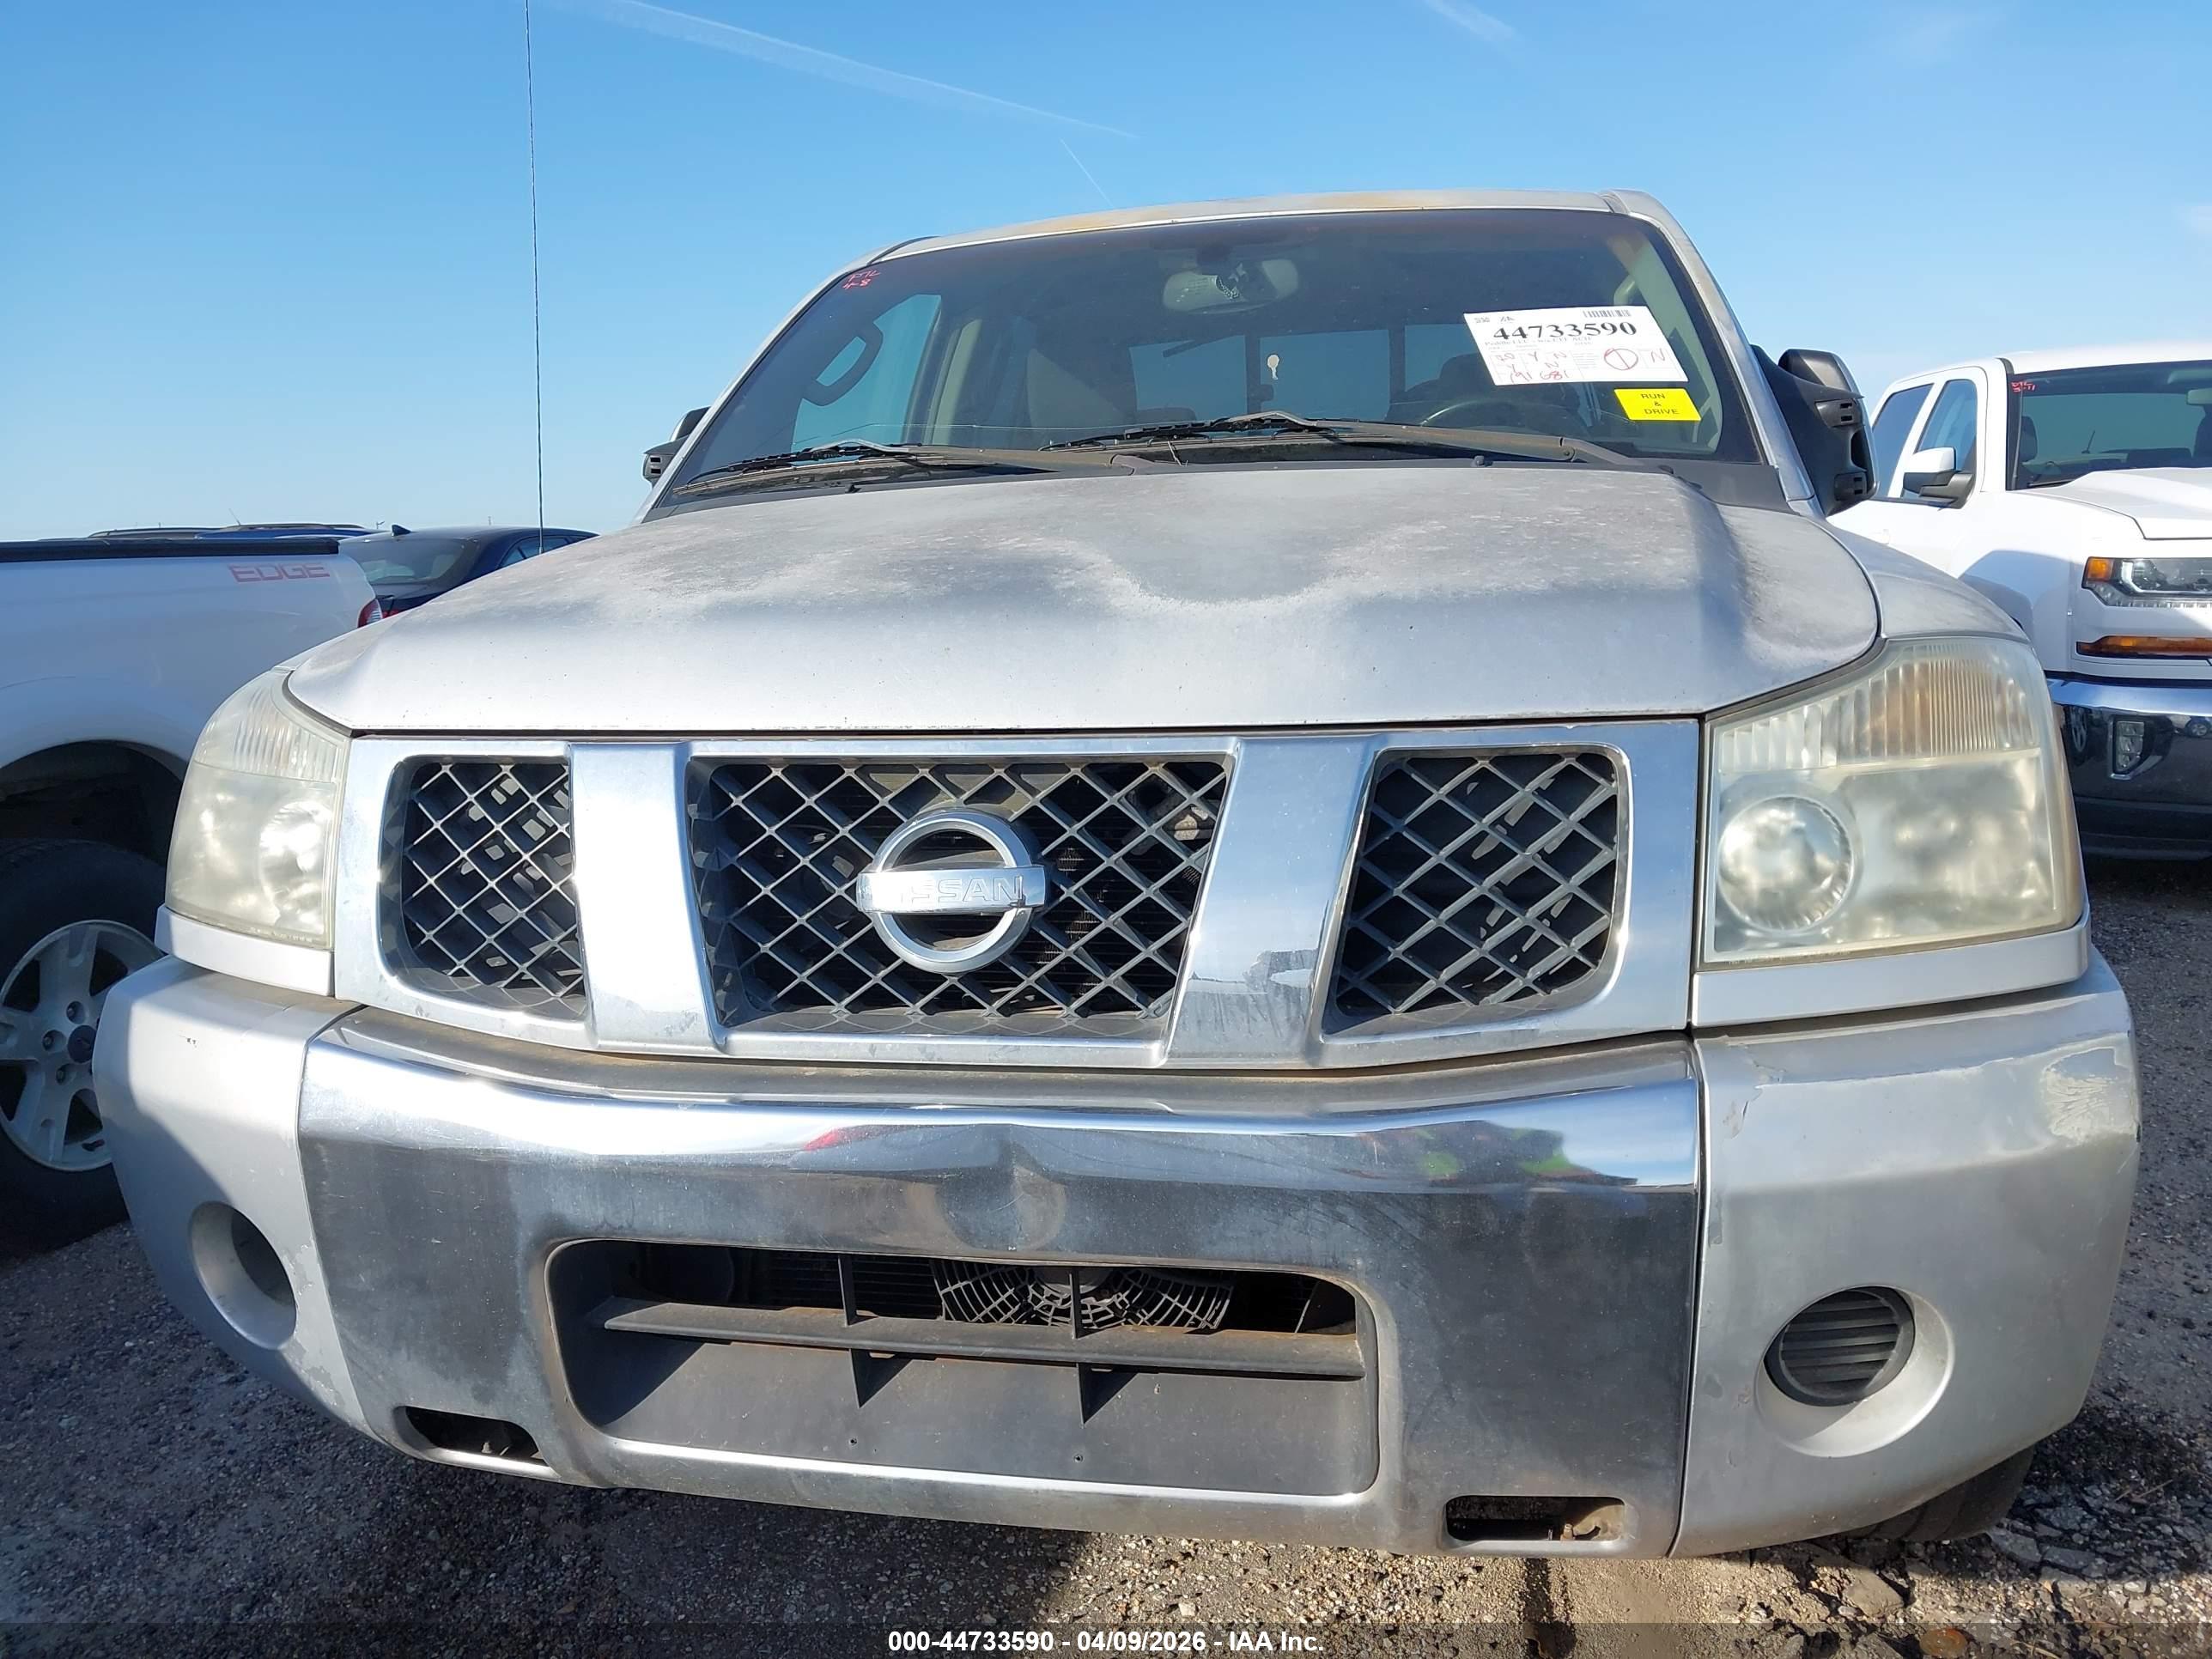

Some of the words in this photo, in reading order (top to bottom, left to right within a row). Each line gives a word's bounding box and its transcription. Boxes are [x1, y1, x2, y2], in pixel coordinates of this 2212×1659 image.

[1492, 321, 1638, 340] 44733590
[228, 562, 331, 585] EDGE
[888, 875, 1024, 904] SSAN
